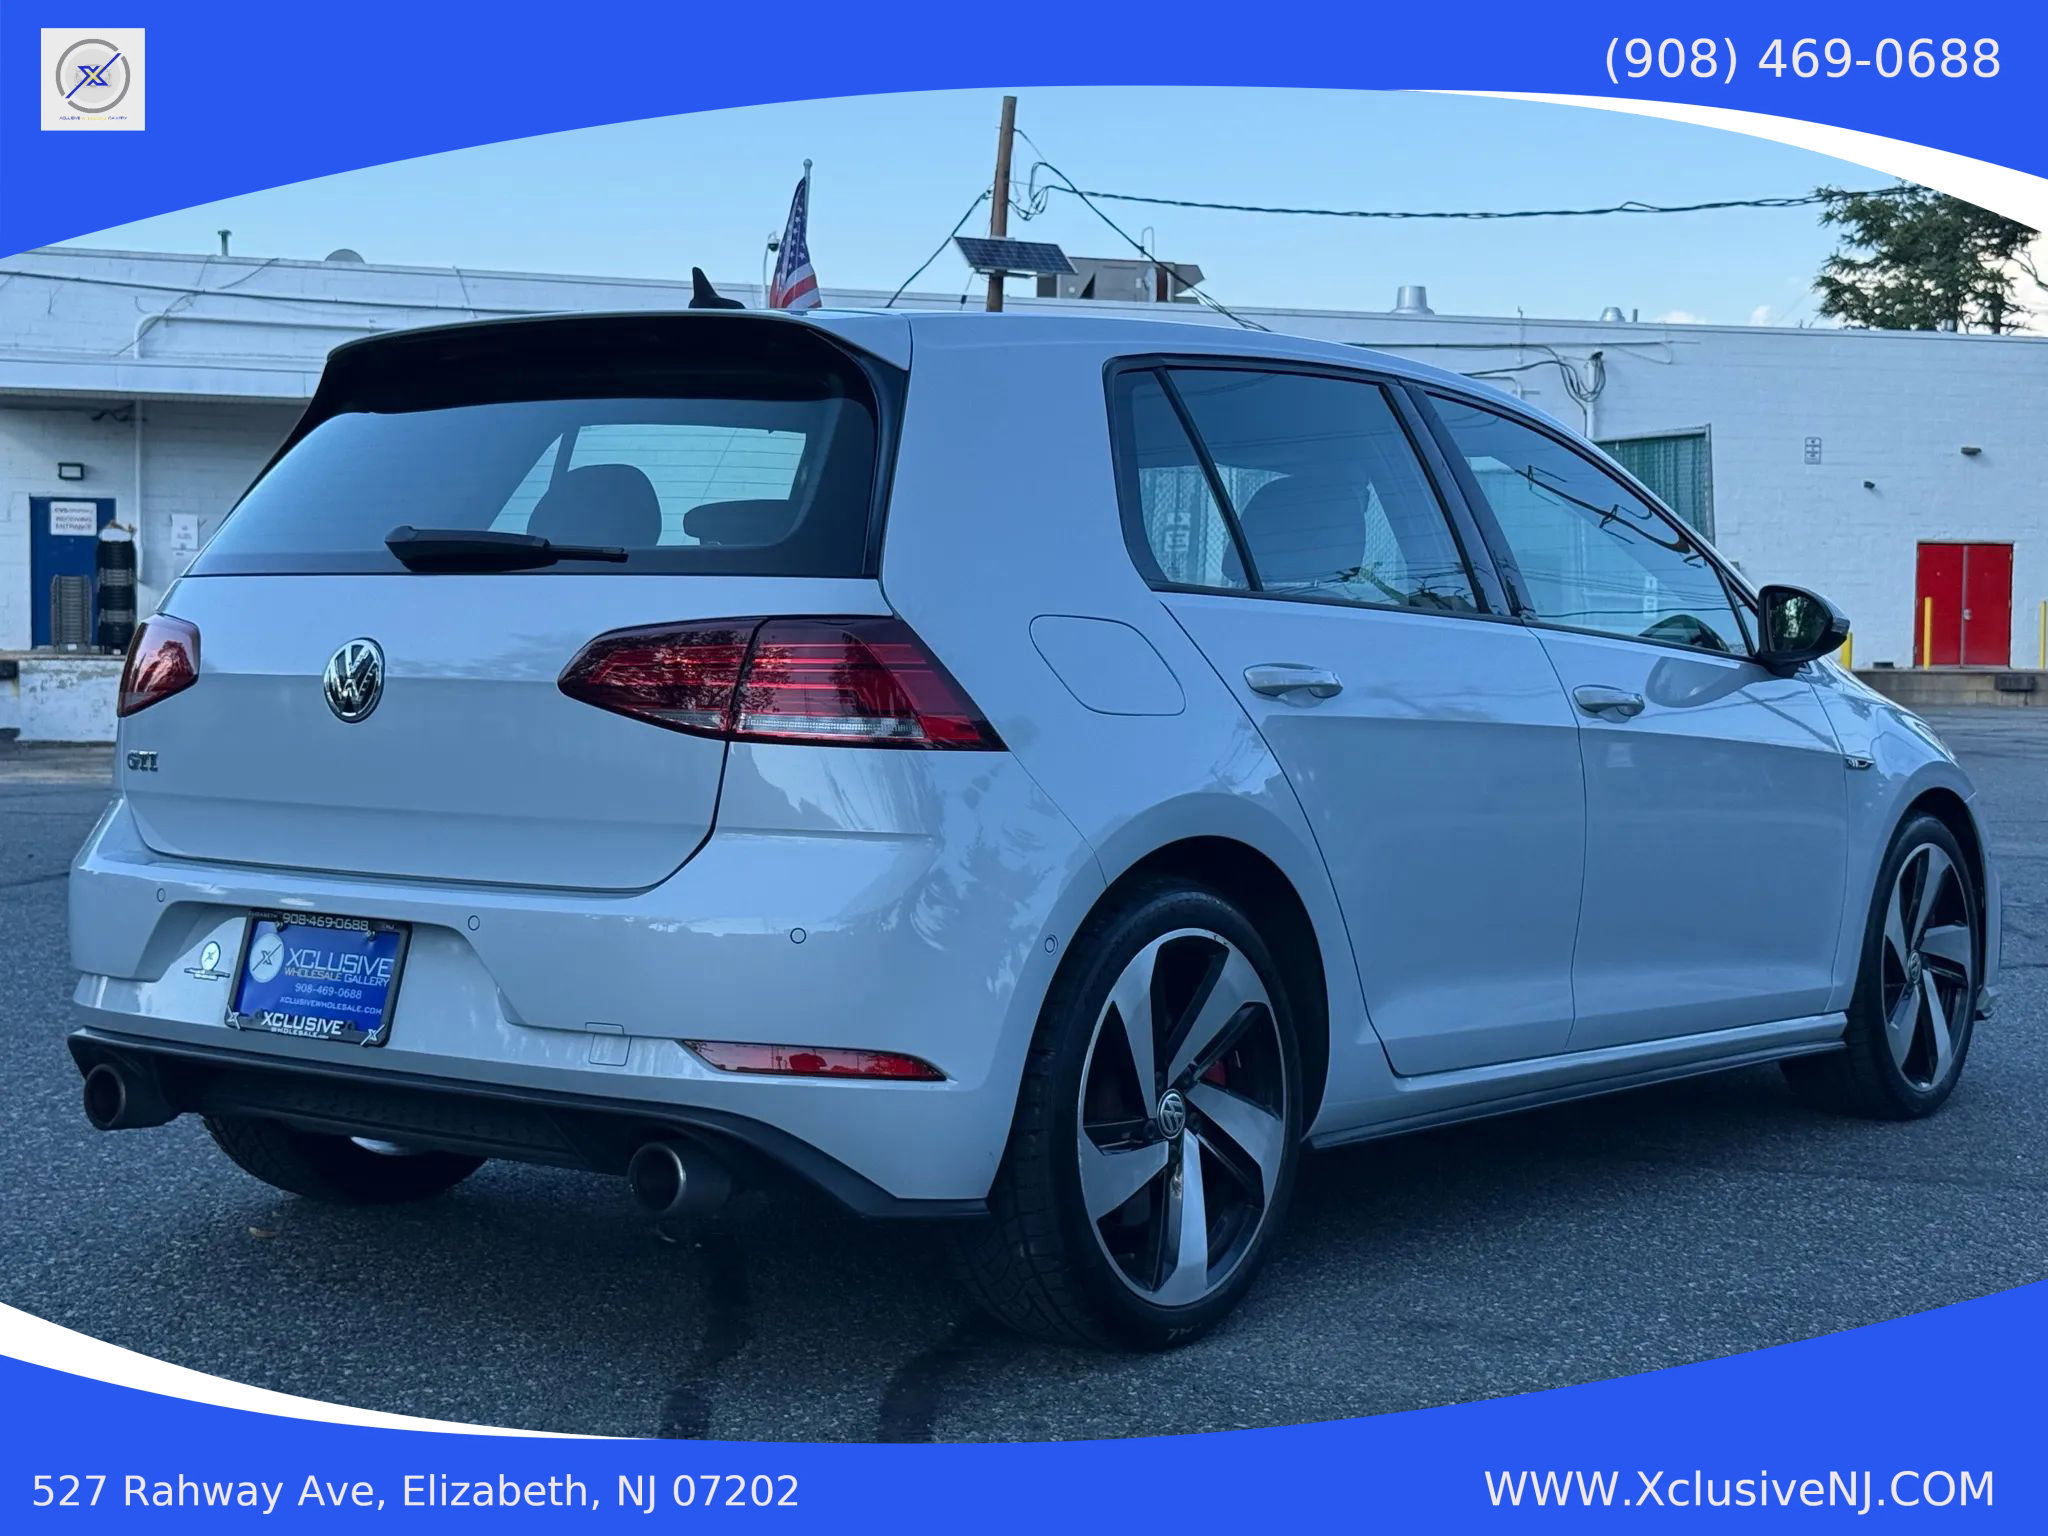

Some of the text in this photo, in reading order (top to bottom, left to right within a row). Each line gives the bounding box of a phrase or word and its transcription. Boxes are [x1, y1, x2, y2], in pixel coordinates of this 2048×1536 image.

[127, 750, 159, 772] GTI
[285, 948, 395, 978] XCLUSIVE
[284, 967, 391, 988] WHOLESALE GALLERY
[294, 982, 363, 1000] 908-469-0688
[279, 996, 383, 1015] XCLUSIVEWHOLESALE.COM
[261, 1011, 345, 1036] XCLUSIVE
